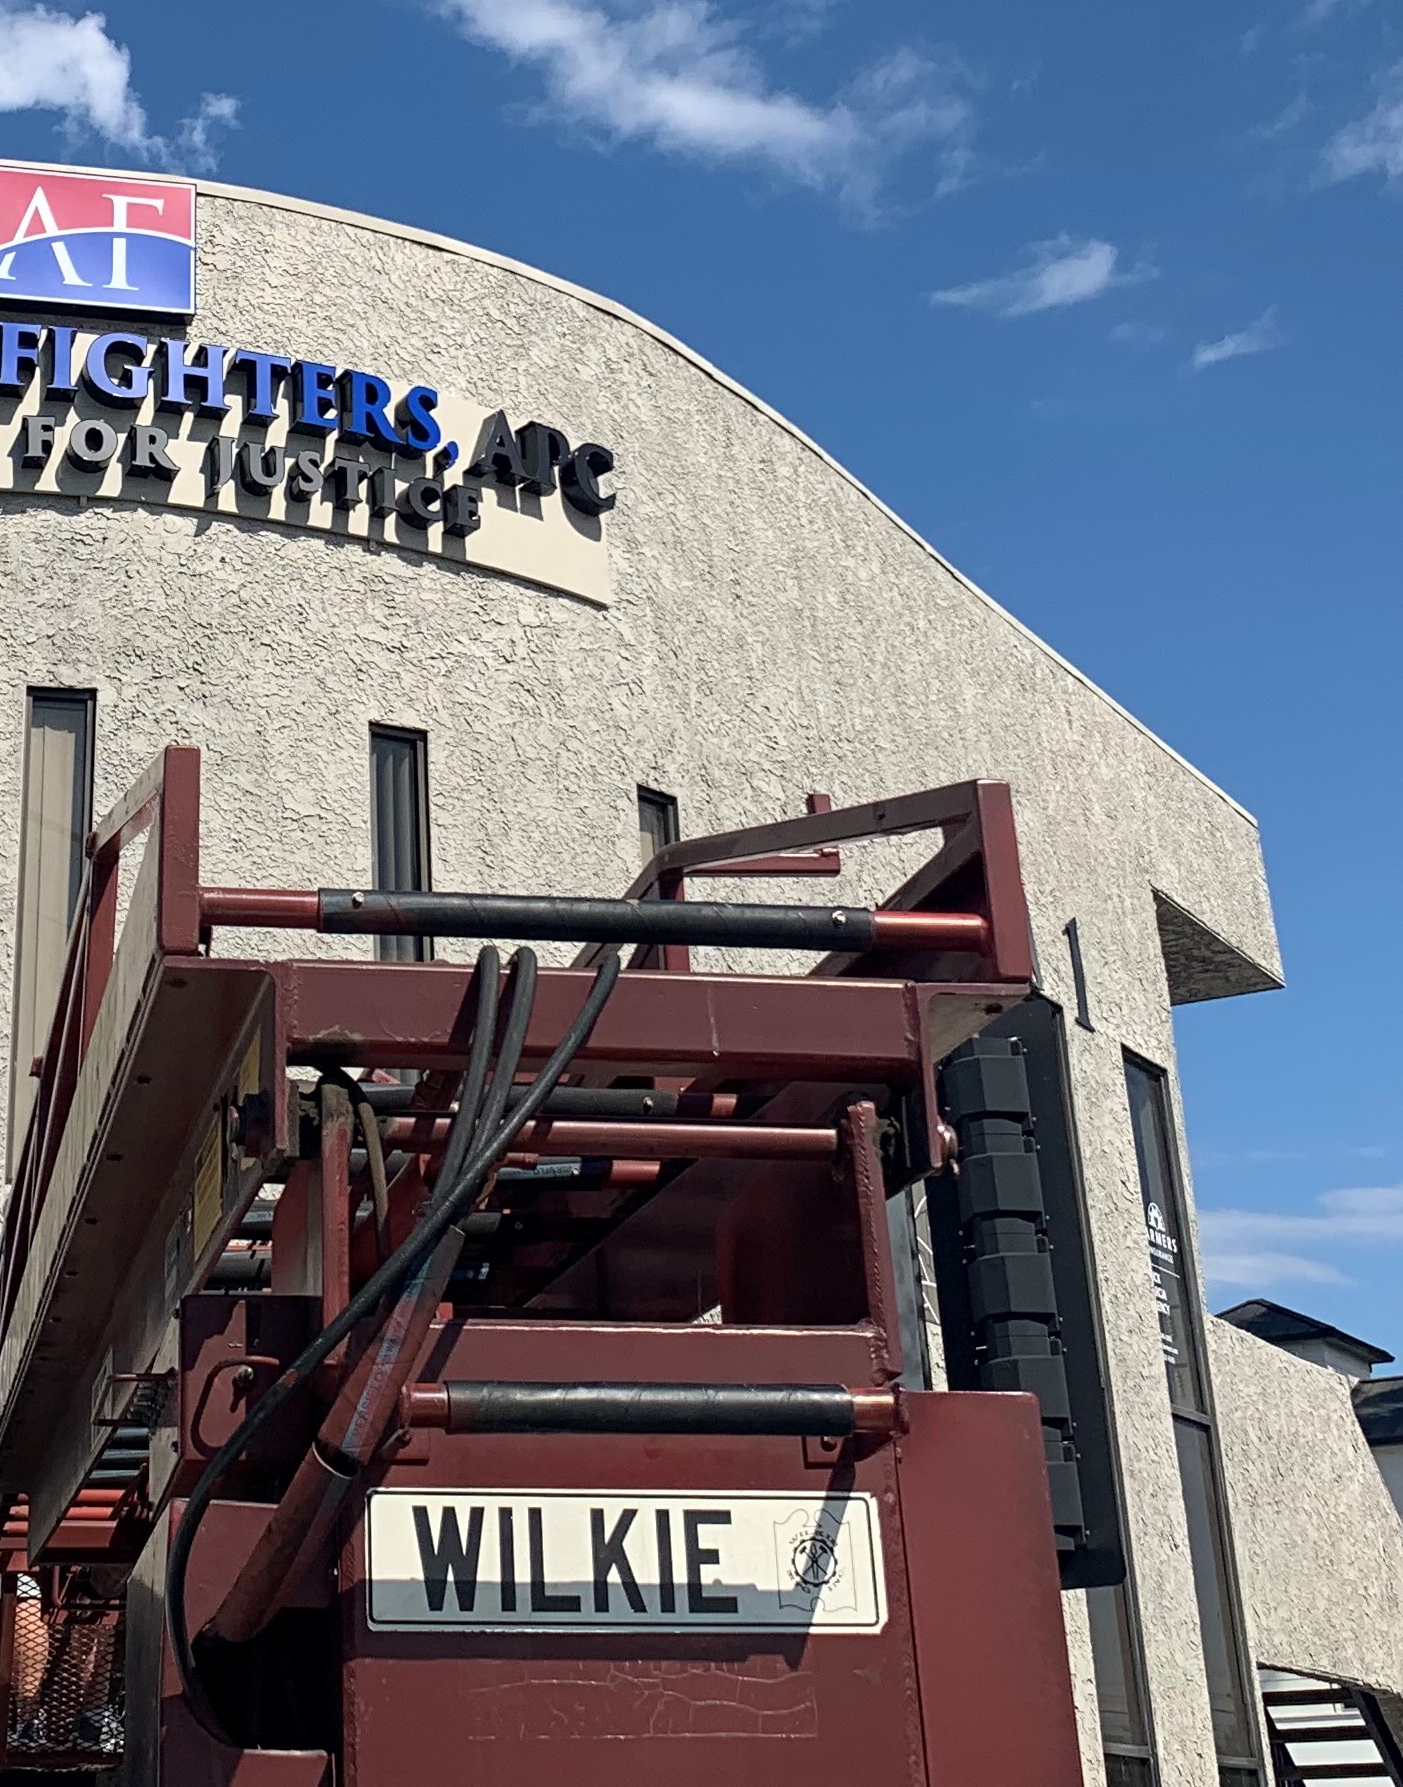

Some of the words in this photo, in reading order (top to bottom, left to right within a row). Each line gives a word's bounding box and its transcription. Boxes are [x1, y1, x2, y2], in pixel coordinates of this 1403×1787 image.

[22, 415, 181, 480] FOR
[202, 434, 483, 538] JUSTICE
[468, 409, 615, 515] APC
[411, 1504, 738, 1614] WILKIE
